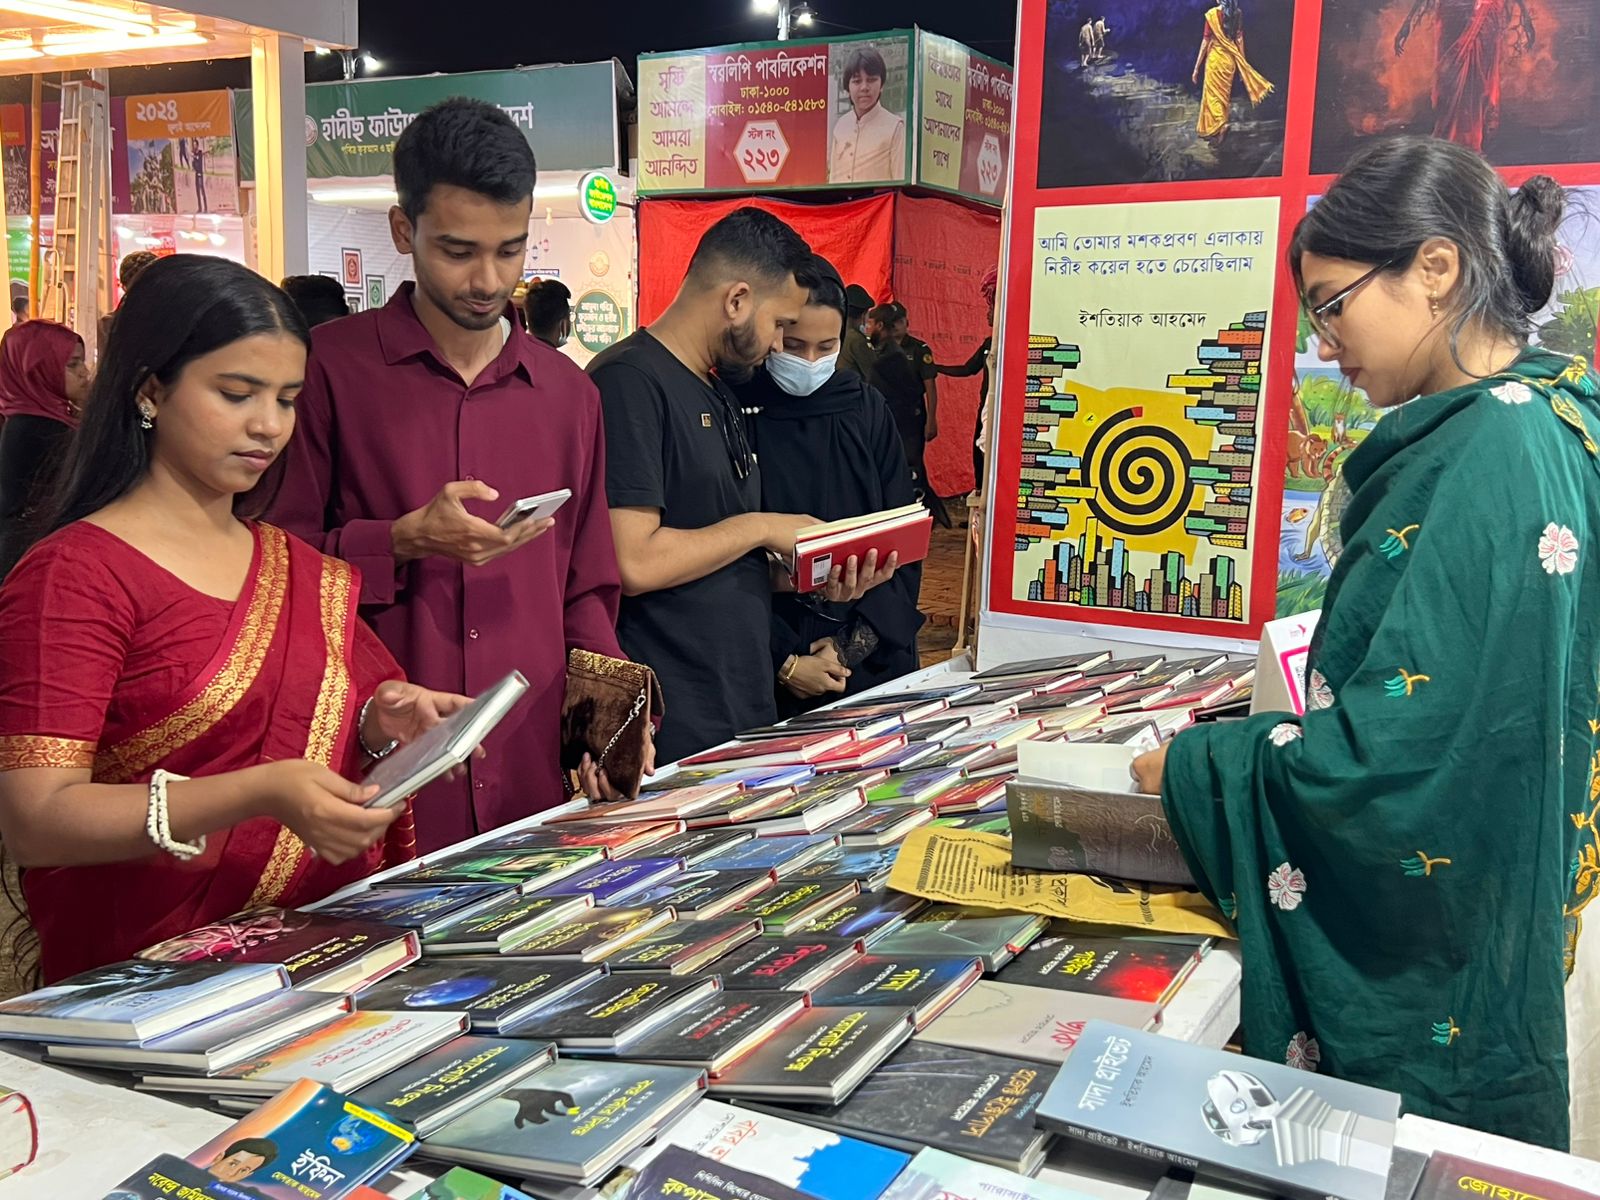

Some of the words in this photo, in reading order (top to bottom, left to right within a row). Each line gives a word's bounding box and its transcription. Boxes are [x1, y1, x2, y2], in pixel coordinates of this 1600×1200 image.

[708, 55, 751, 85] স্বরলিপি
[755, 51, 827, 80] পাবলিকেশন
[658, 67, 687, 93] সৃষ্টি
[740, 84, 790, 99] ঢাকা-১০০০
[135, 100, 177, 121] ২০২৪
[747, 99, 826, 114] ০১৫৪০-৫৪১৫৮৩
[935, 90, 952, 109] সাথে
[321, 108, 365, 142] হাদীছ
[748, 128, 763, 140] স্টল
[766, 129, 776, 140] নং
[924, 117, 961, 142] আপনাদের
[652, 129, 691, 147] আমরা
[645, 154, 699, 178] আনন্দিত
[743, 148, 780, 172] ২২৩
[933, 150, 949, 168] পাশে
[981, 160, 998, 183] ২২৩
[1038, 231, 1068, 252] আমি
[1073, 235, 1121, 251] তোমার
[1127, 233, 1198, 249] মশকপ্রবণ
[1204, 230, 1264, 247] এলাকায়
[1044, 256, 1082, 276] নিরীহ
[1087, 259, 1130, 275] কয়েল
[1136, 258, 1167, 274] হতে
[1173, 252, 1254, 273] চেয়েছিলাম
[1078, 308, 1144, 328] ইশতিয়াক
[1149, 312, 1207, 328] আহমেদ
[1093, 1035, 1132, 1081] প্রাইভেট
[1078, 1080, 1113, 1111] সাদা
[1067, 1125, 1086, 1137] সাদা
[1087, 1131, 1119, 1147] প্রাইভেট
[1126, 1141, 1165, 1159] ইশতিয়াক
[1166, 1151, 1200, 1168] আহমেদ
[291, 1148, 346, 1190] ইফিন
[148, 1172, 181, 1195] নরেন্দ্র
